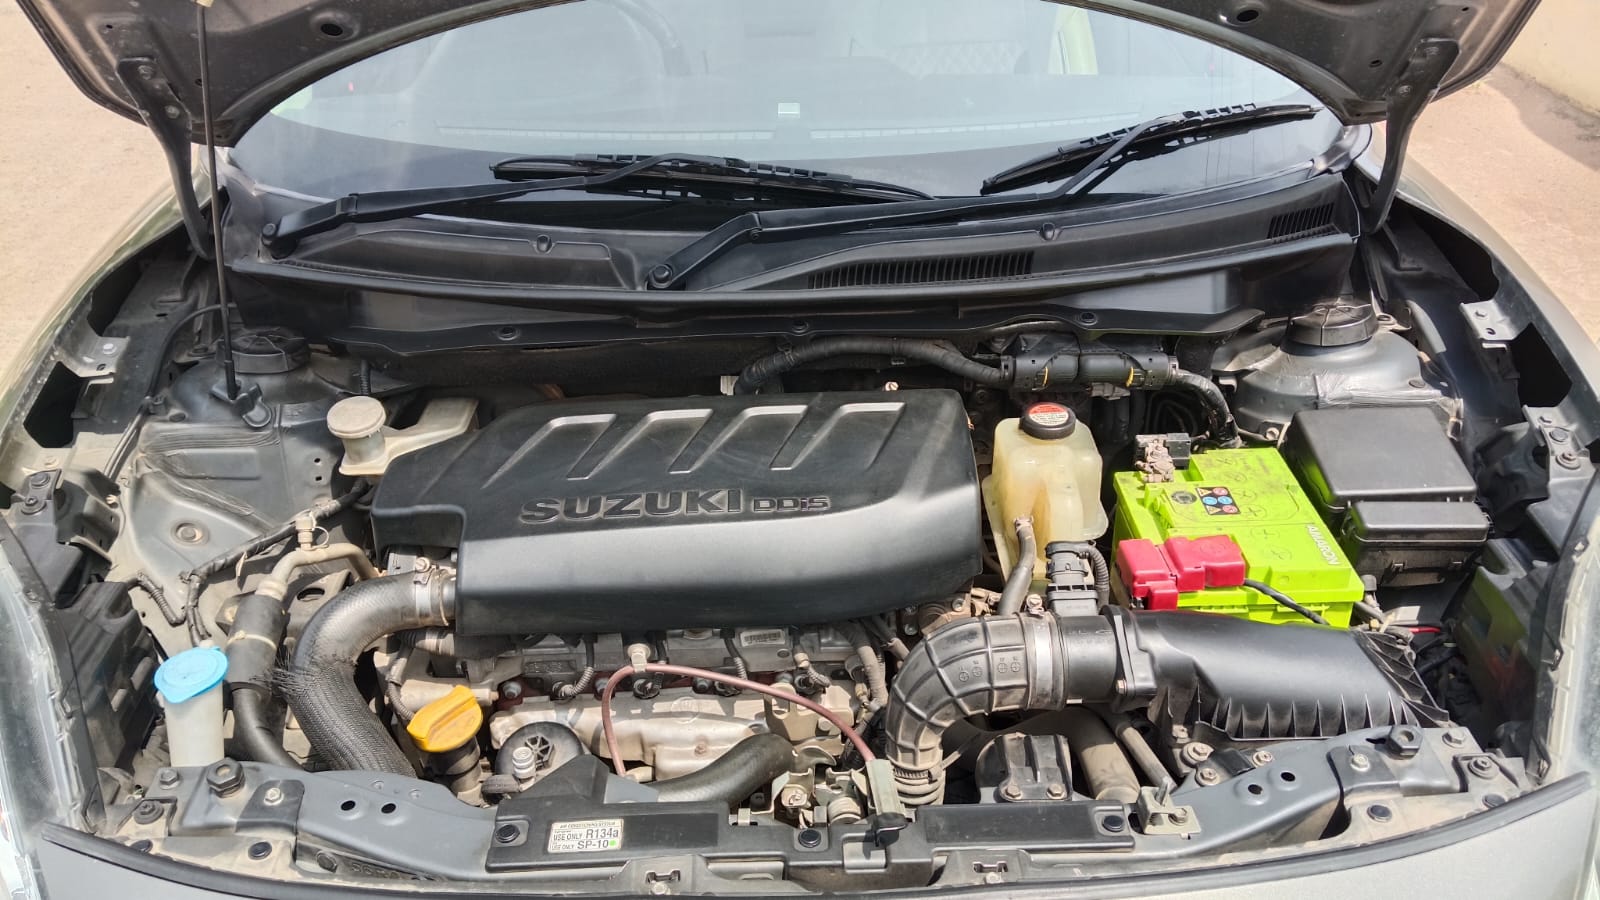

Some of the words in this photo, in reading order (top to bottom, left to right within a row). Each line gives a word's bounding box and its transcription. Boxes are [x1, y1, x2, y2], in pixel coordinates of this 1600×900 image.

[520, 490, 742, 524] SUZUKI
[1306, 525, 1342, 565] AMARON
[577, 840, 609, 849] SP-10
[586, 828, 619, 839] R134a
